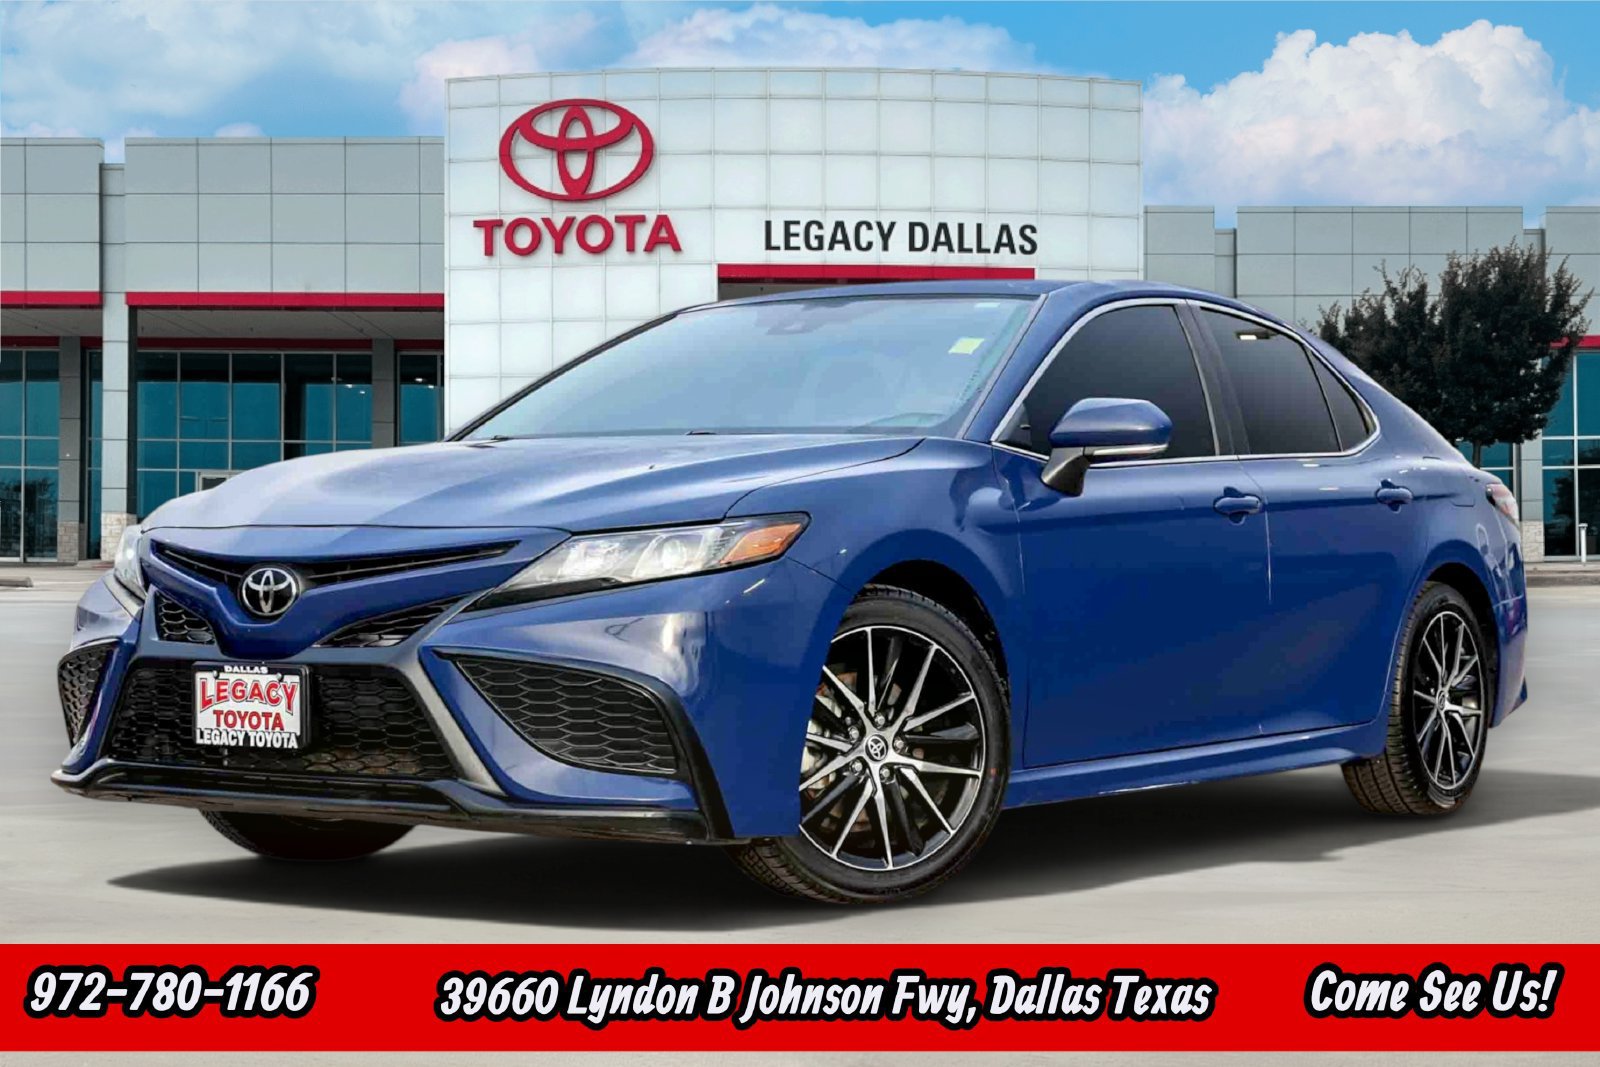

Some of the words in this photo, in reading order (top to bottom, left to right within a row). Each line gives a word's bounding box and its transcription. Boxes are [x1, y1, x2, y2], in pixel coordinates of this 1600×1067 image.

[474, 214, 682, 257] TOYOTA
[765, 220, 896, 252] LEGACY
[908, 221, 1038, 255] DALLAS
[223, 665, 268, 674] DALLAS
[200, 678, 299, 715] LEGACY
[213, 709, 285, 731] TOYOTA
[196, 728, 246, 746] LEGACY
[246, 731, 298, 749] TOYOTA
